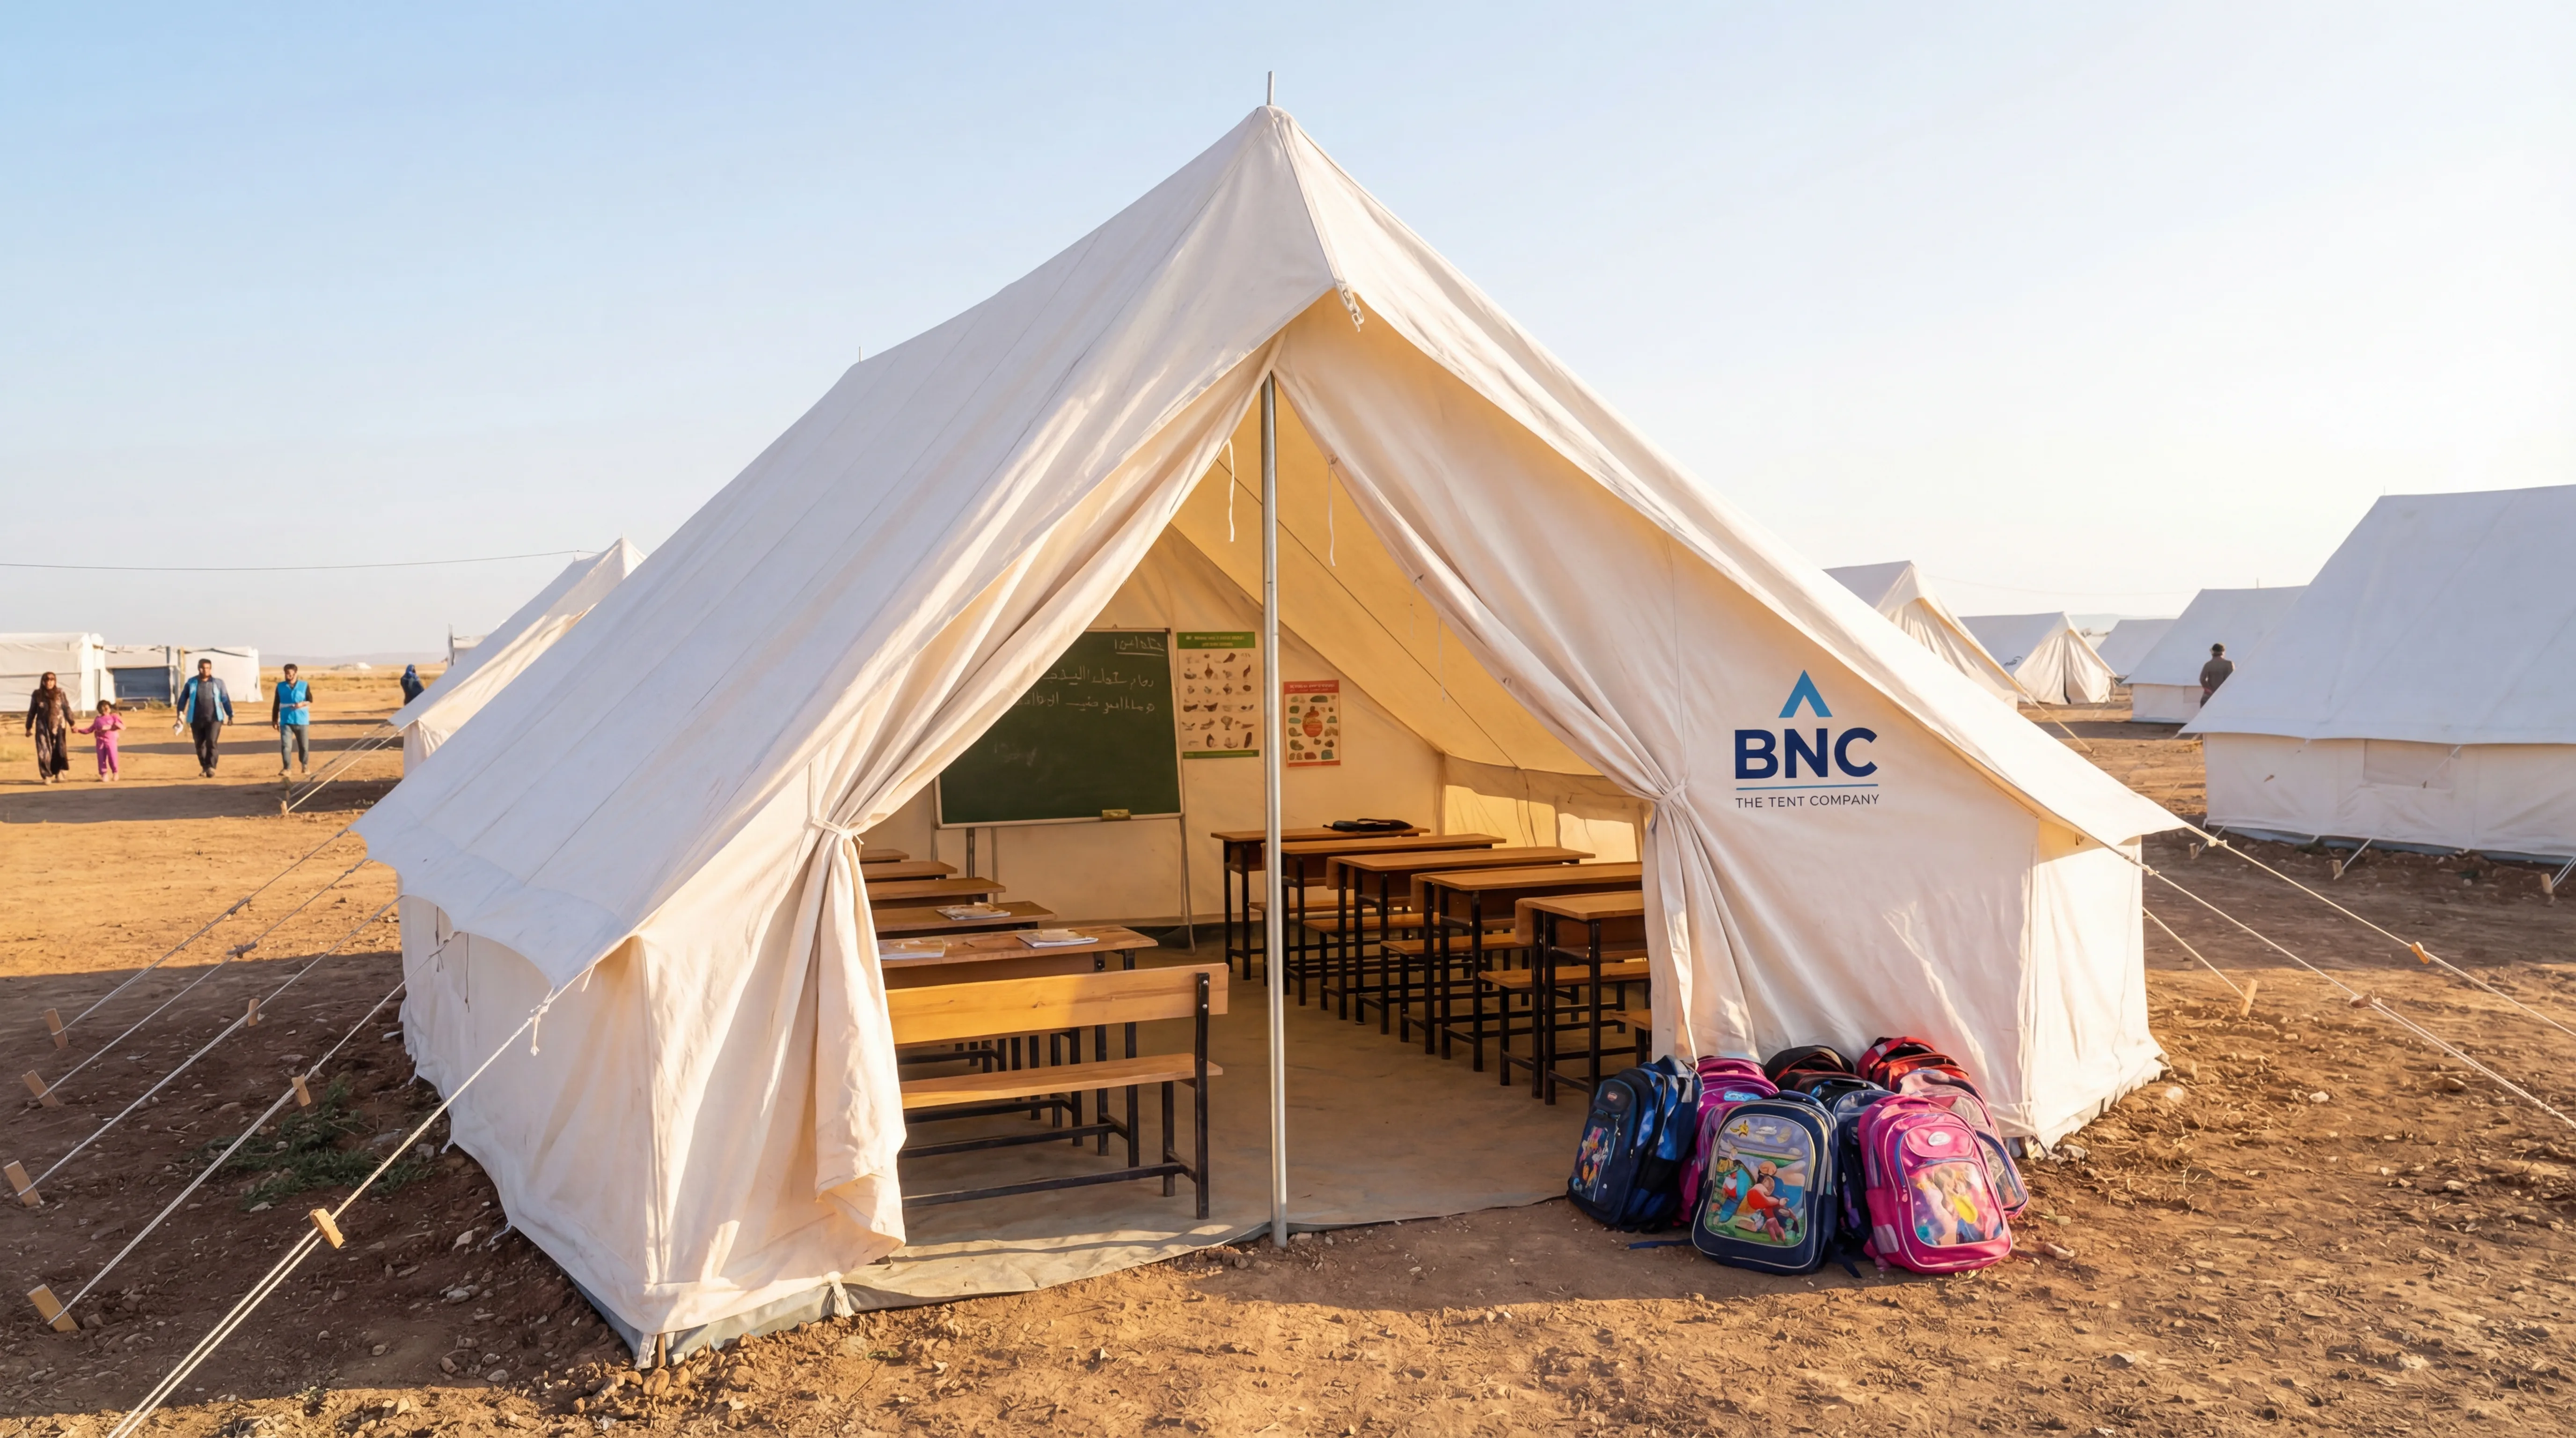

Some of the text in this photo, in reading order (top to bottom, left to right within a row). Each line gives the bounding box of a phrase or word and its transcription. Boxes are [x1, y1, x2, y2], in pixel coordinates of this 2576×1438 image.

[1735, 727, 1877, 779] BNC
[1735, 794, 1879, 808] THE TENT COMPANY
